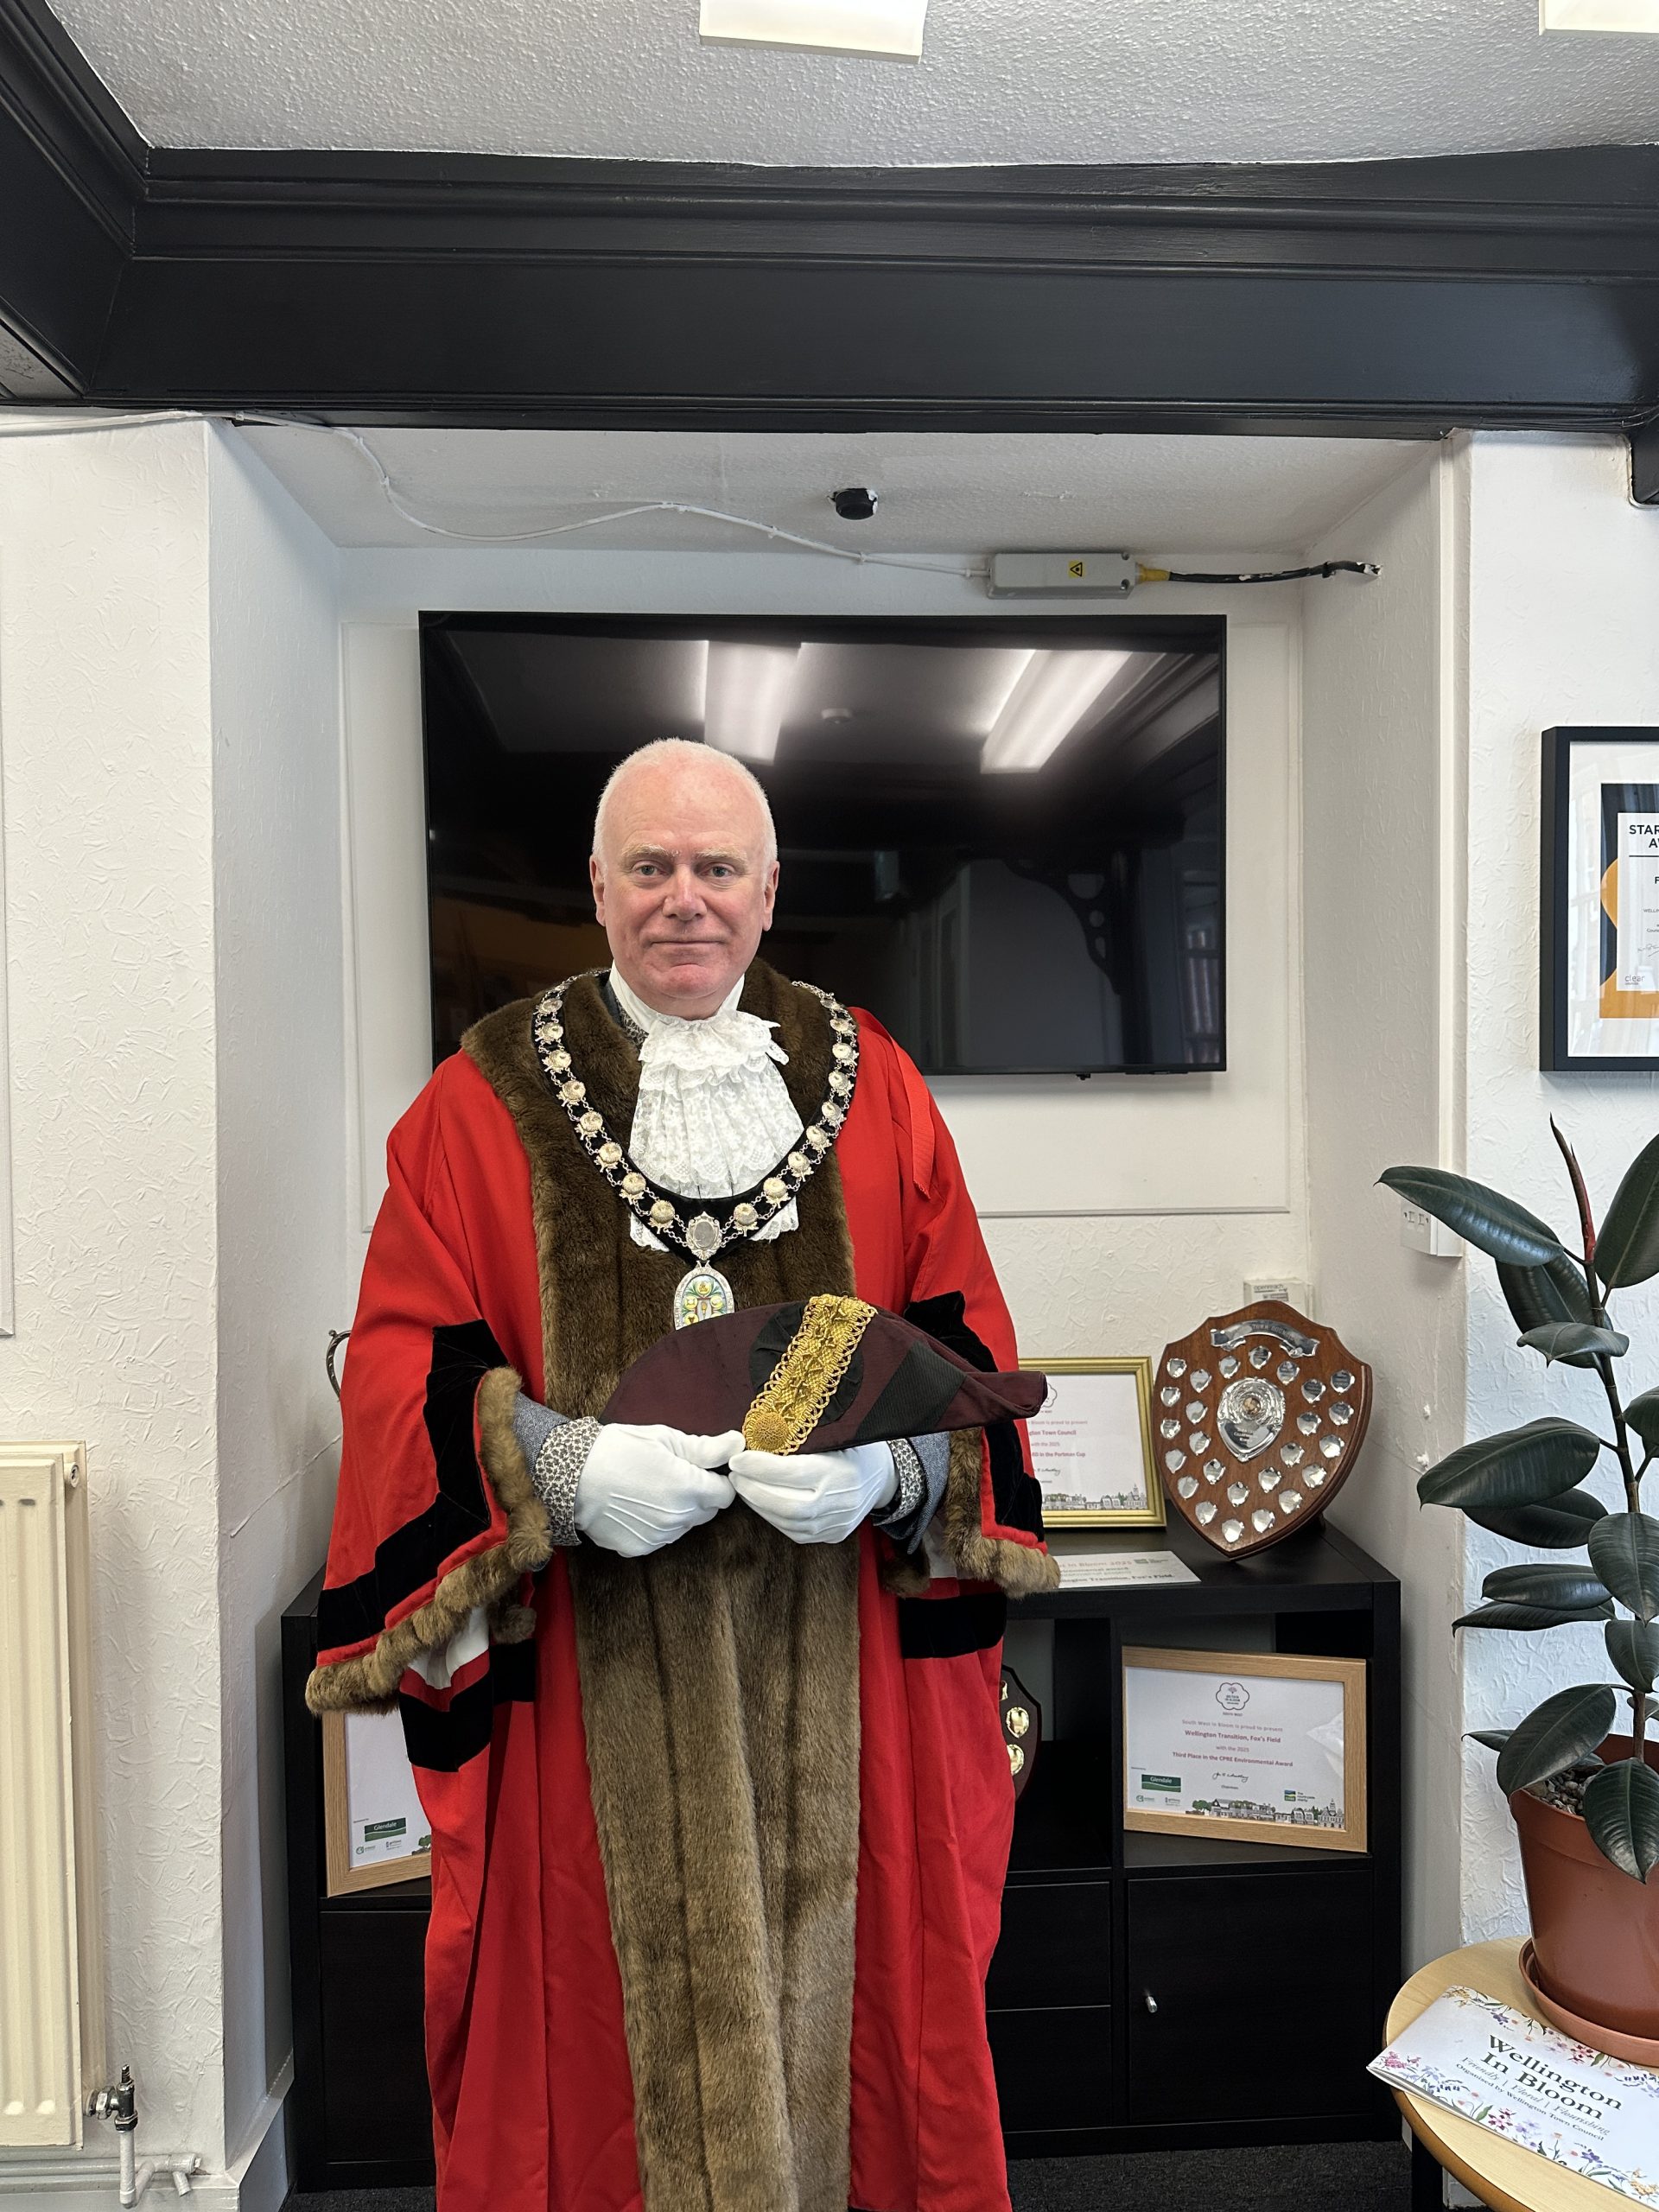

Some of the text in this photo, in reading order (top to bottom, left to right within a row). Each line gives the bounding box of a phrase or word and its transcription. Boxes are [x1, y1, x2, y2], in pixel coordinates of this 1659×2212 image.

[1649, 838, 1659, 848] A
[1217, 1732, 1249, 1741] Transition,
[1234, 1757, 1274, 1765] Environmental
[373, 1821, 397, 1831] Glendale
[1480, 2051, 1603, 2120] In Bloom
[1490, 2034, 1622, 2110] Wellington
[1456, 2063, 1605, 2141] Organised by Wellington Town Council
[1462, 2056, 1499, 2081] Friendly
[1511, 2084, 1543, 2102] Floral
[1554, 2106, 1611, 2136] Flourishing
